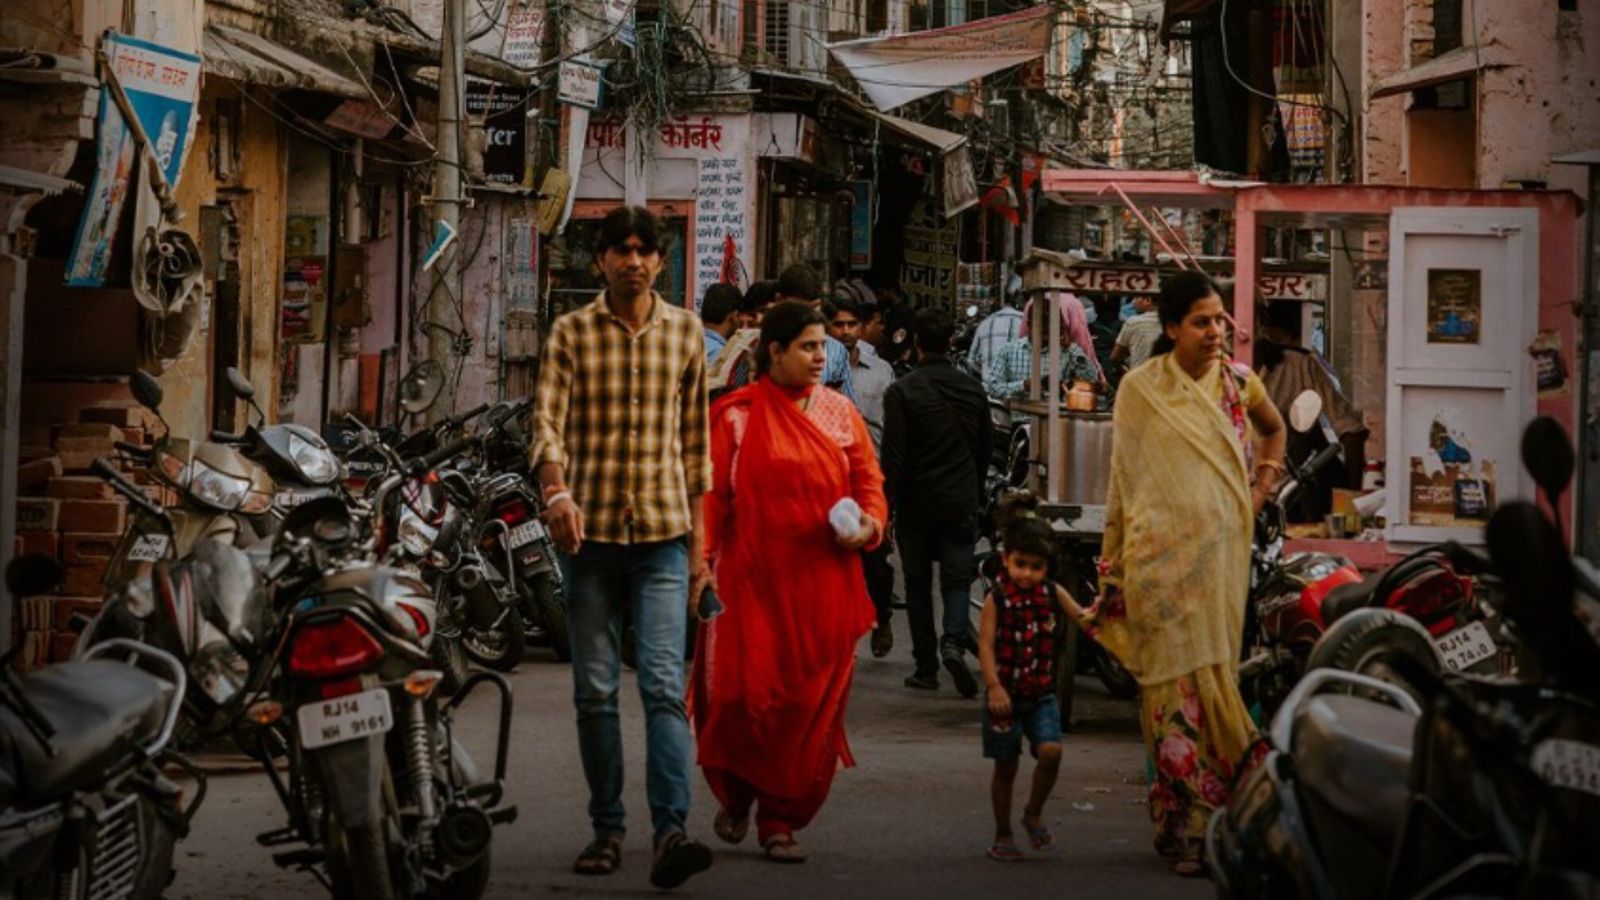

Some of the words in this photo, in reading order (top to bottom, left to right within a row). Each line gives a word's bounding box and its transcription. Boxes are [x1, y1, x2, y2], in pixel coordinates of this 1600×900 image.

[486, 126, 516, 146] ter
[660, 115, 723, 151] कॉर्नर
[1258, 273, 1304, 296] डार
[1439, 631, 1471, 655] RJ14
[322, 700, 359, 718] RJ14
[321, 725, 341, 740] NH
[350, 715, 386, 734] 9161
